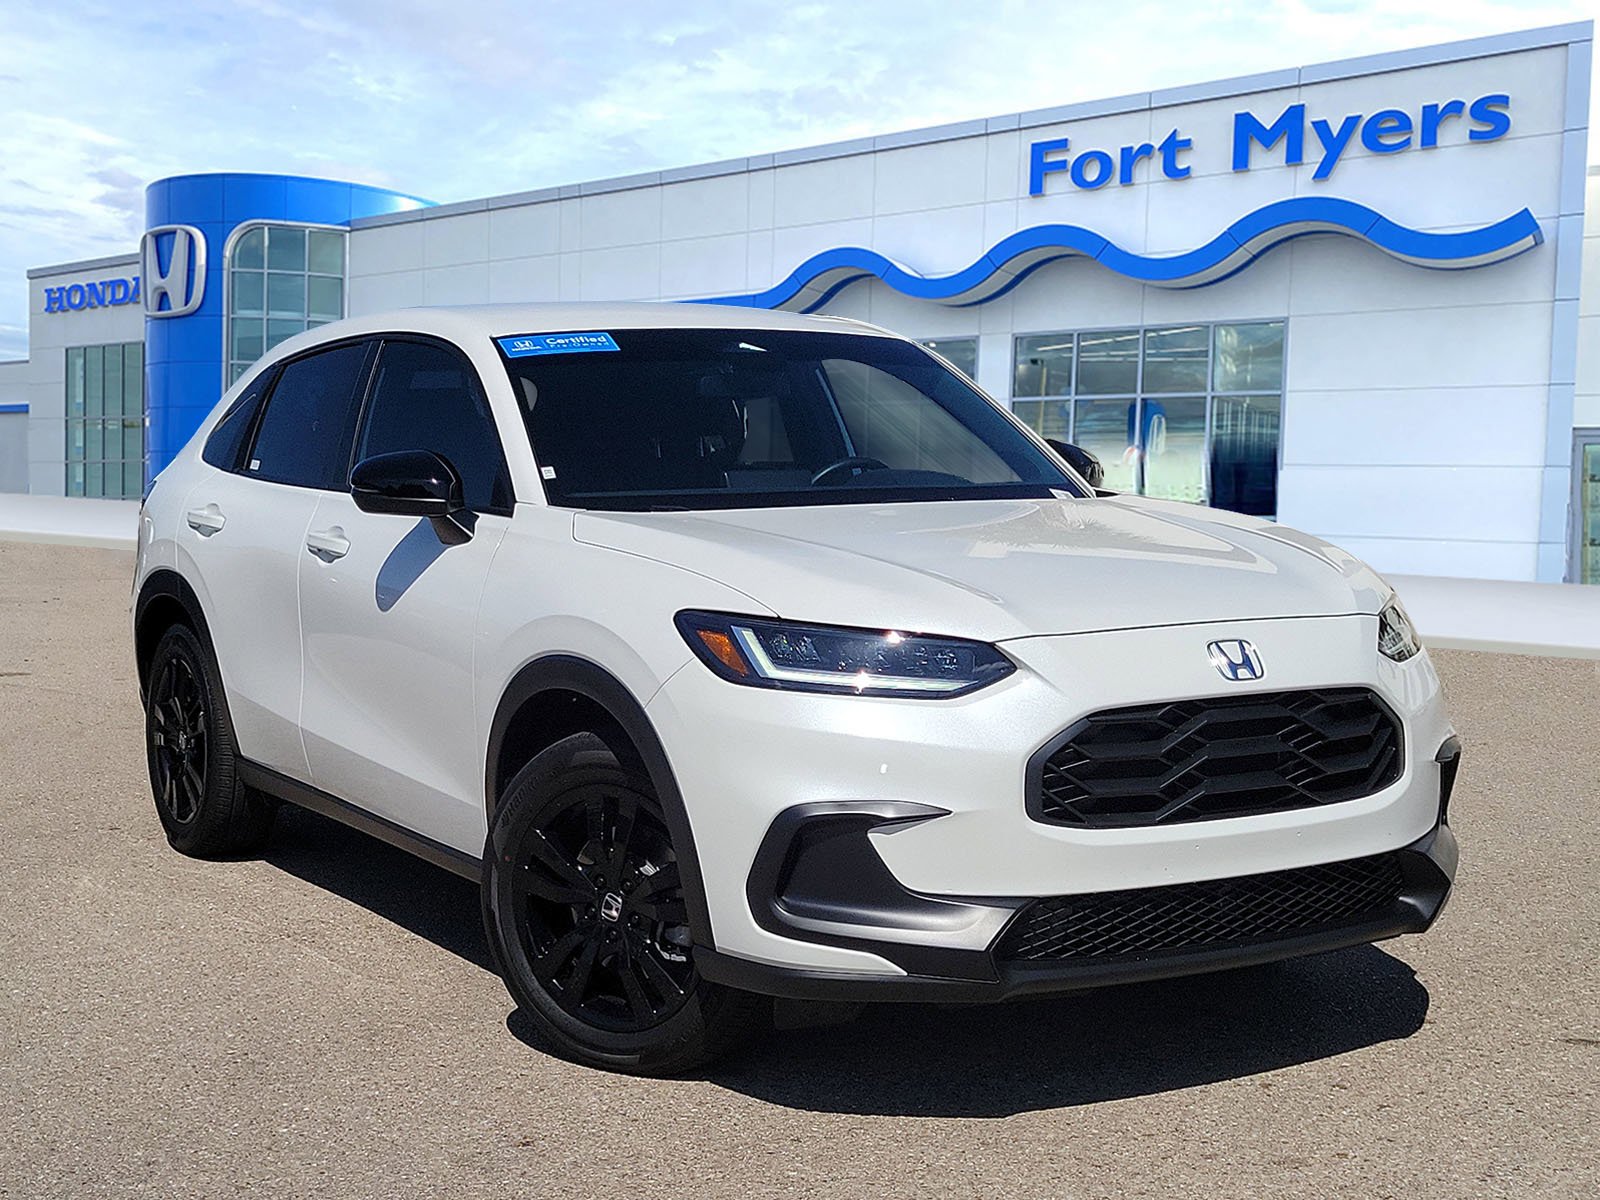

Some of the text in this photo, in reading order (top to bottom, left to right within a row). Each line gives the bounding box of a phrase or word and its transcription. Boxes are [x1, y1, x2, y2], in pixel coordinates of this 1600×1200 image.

[1029, 93, 1512, 197] Fort Myers
[545, 335, 607, 345] Certified
